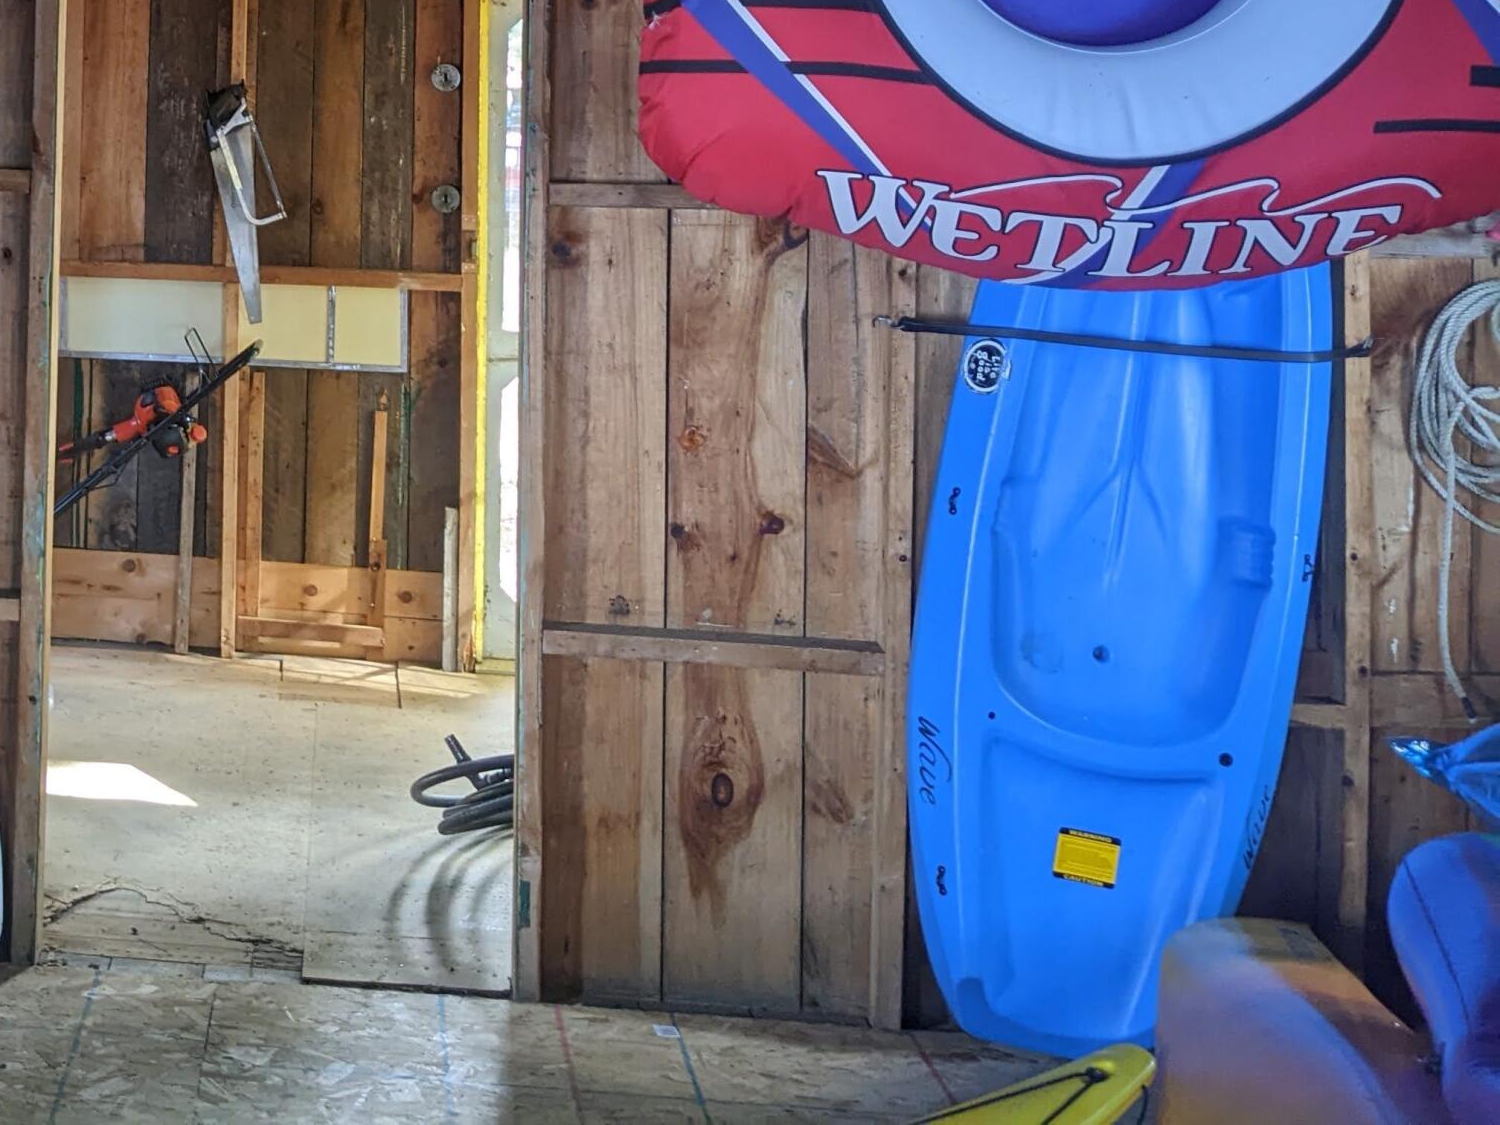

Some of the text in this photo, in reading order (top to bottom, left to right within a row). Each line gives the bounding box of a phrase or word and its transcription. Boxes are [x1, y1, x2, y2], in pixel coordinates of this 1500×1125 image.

[815, 169, 1406, 279] WETLINE
[918, 716, 953, 805] Wave
[1069, 830, 1113, 843] WARNING
[1063, 874, 1104, 886] CAUTION
